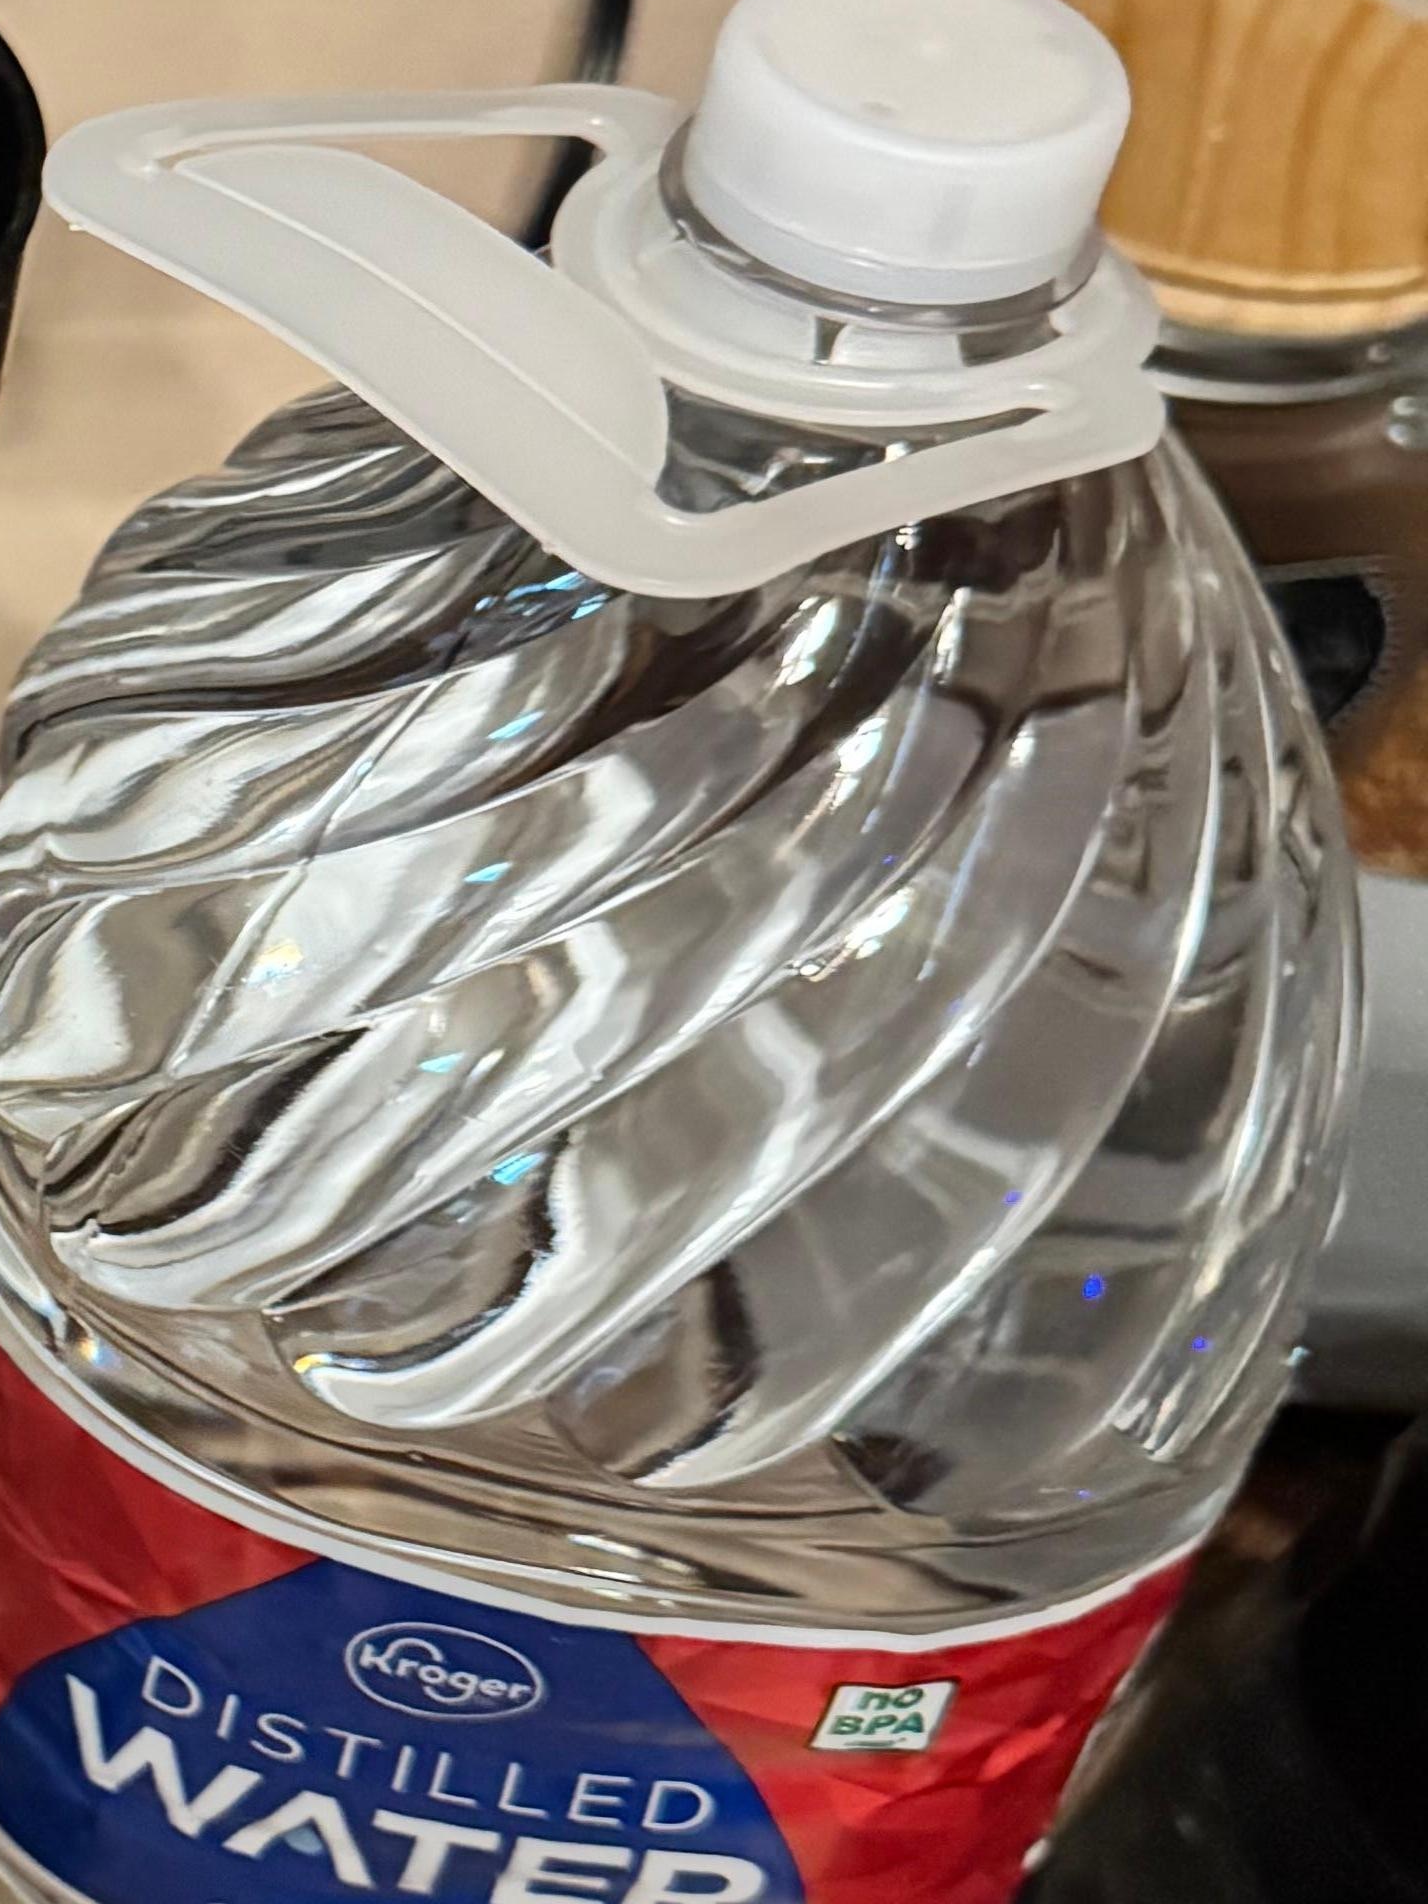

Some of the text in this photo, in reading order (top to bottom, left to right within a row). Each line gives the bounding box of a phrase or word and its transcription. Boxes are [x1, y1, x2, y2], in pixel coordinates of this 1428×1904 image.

[357, 1636, 535, 1703] Kroger
[141, 1654, 716, 1835] DISTILLED
[830, 1712, 924, 1735] BPA
